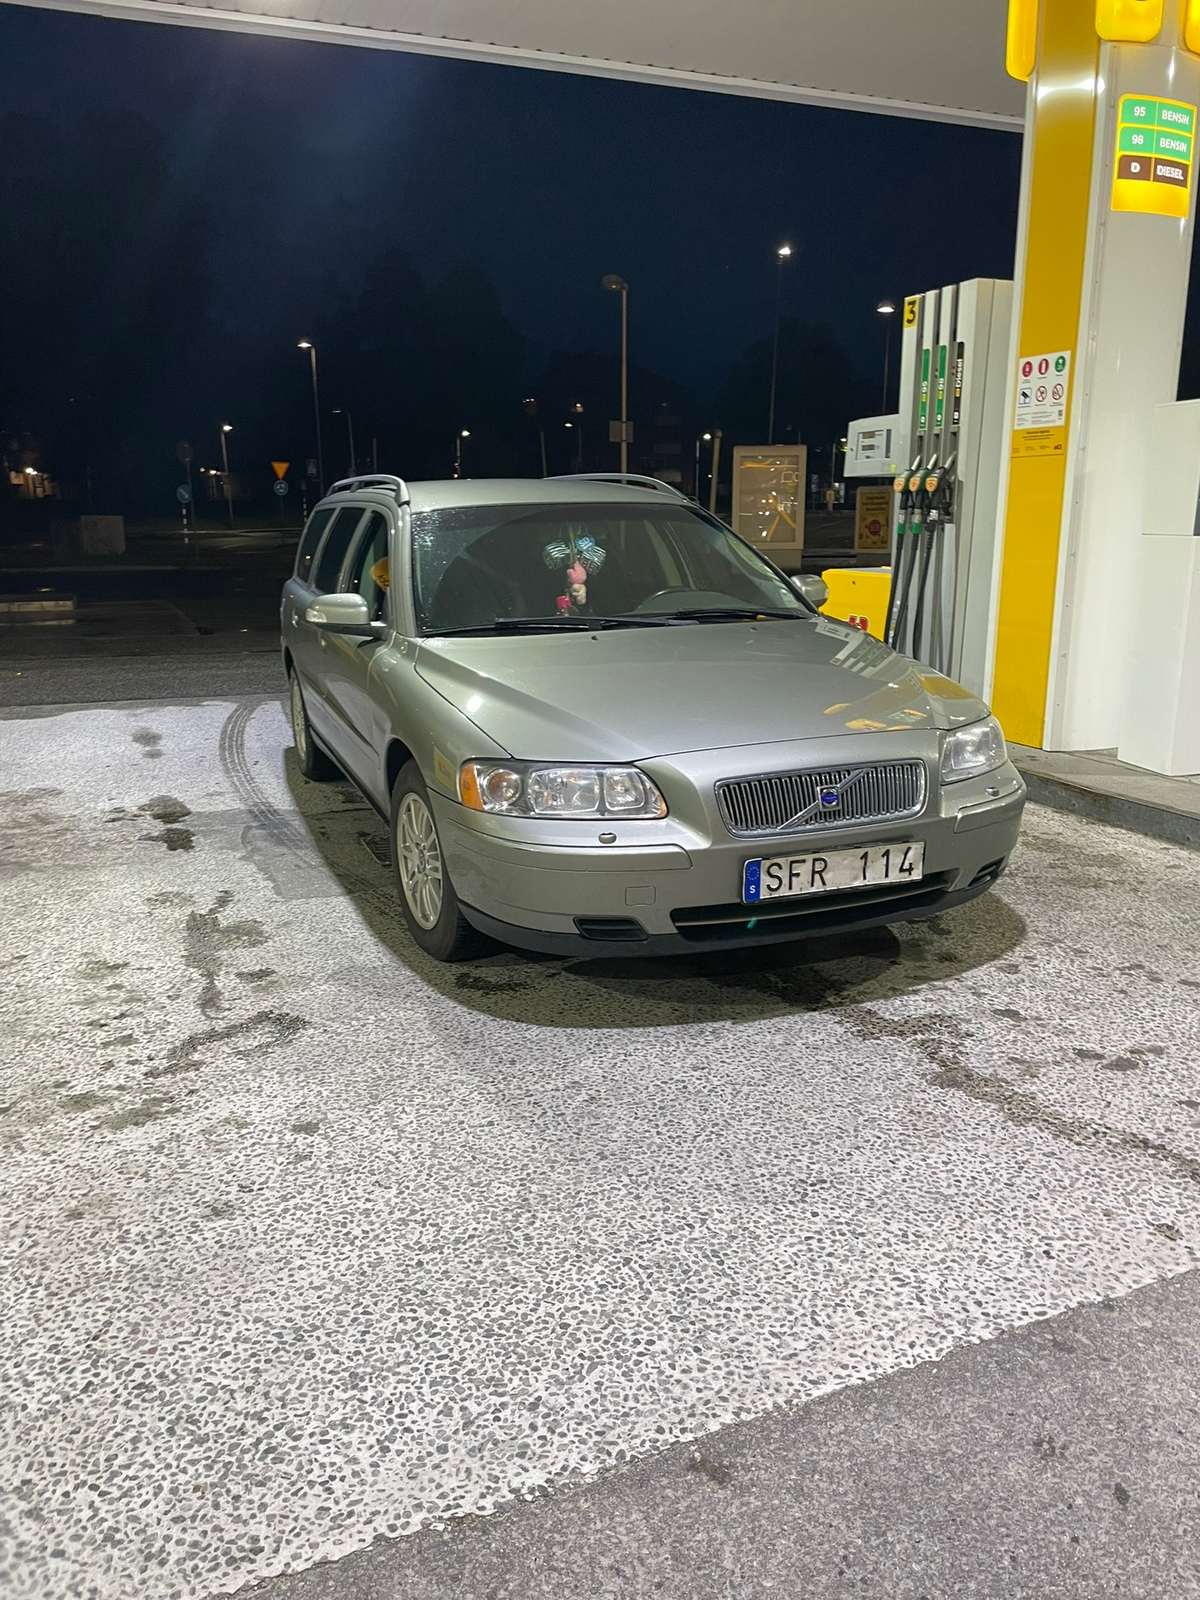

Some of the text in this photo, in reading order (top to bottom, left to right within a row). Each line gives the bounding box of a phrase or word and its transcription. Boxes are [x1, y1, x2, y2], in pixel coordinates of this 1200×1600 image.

[1133, 106, 1189, 125] 95 BENSIN
[1131, 134, 1187, 153] 98 BENSIN
[1130, 161, 1184, 180] D DIESEL
[906, 299, 917, 325] 3
[766, 846, 914, 893] SFR 114
[749, 884, 756, 894] S
